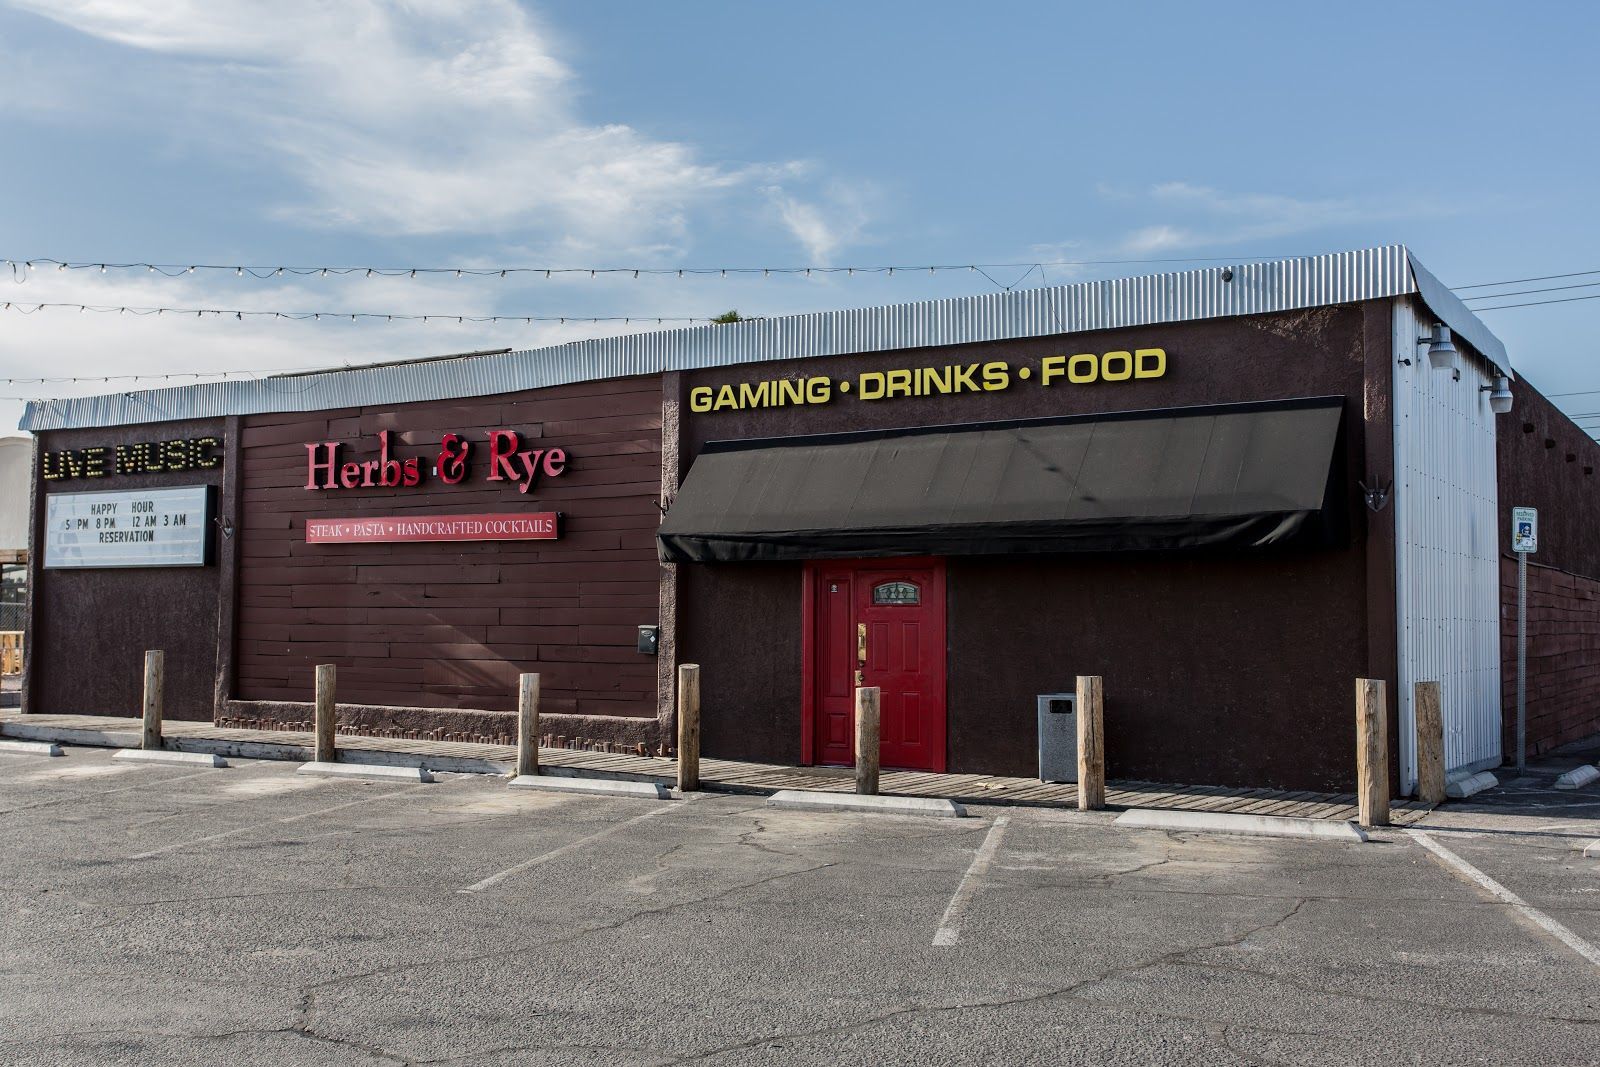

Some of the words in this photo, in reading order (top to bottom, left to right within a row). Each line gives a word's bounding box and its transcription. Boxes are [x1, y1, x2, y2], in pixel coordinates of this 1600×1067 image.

[690, 376, 831, 412] GAMING
[859, 361, 1009, 400] DRINKS
[1042, 348, 1167, 386] FOOD
[44, 448, 105, 479] LIVE
[116, 437, 218, 474] MUSIC
[304, 429, 421, 490] Herbs
[437, 433, 468, 484] &
[485, 430, 566, 494] Rye
[91, 502, 117, 515] HAPPY
[131, 501, 154, 513] HOUR
[65, 519, 70, 530] 5
[77, 518, 89, 530] PM
[96, 517, 101, 529] 8
[104, 517, 116, 529] PM
[132, 516, 140, 527] 12
[145, 515, 157, 527] AM
[163, 515, 169, 526] 3
[173, 514, 186, 526] AM
[309, 525, 343, 538] STEAK
[353, 523, 385, 536] PASTA
[397, 520, 483, 536] HANDCRAFTED
[485, 519, 553, 534] COCKTAILS
[99, 530, 154, 543] RESERVATION
